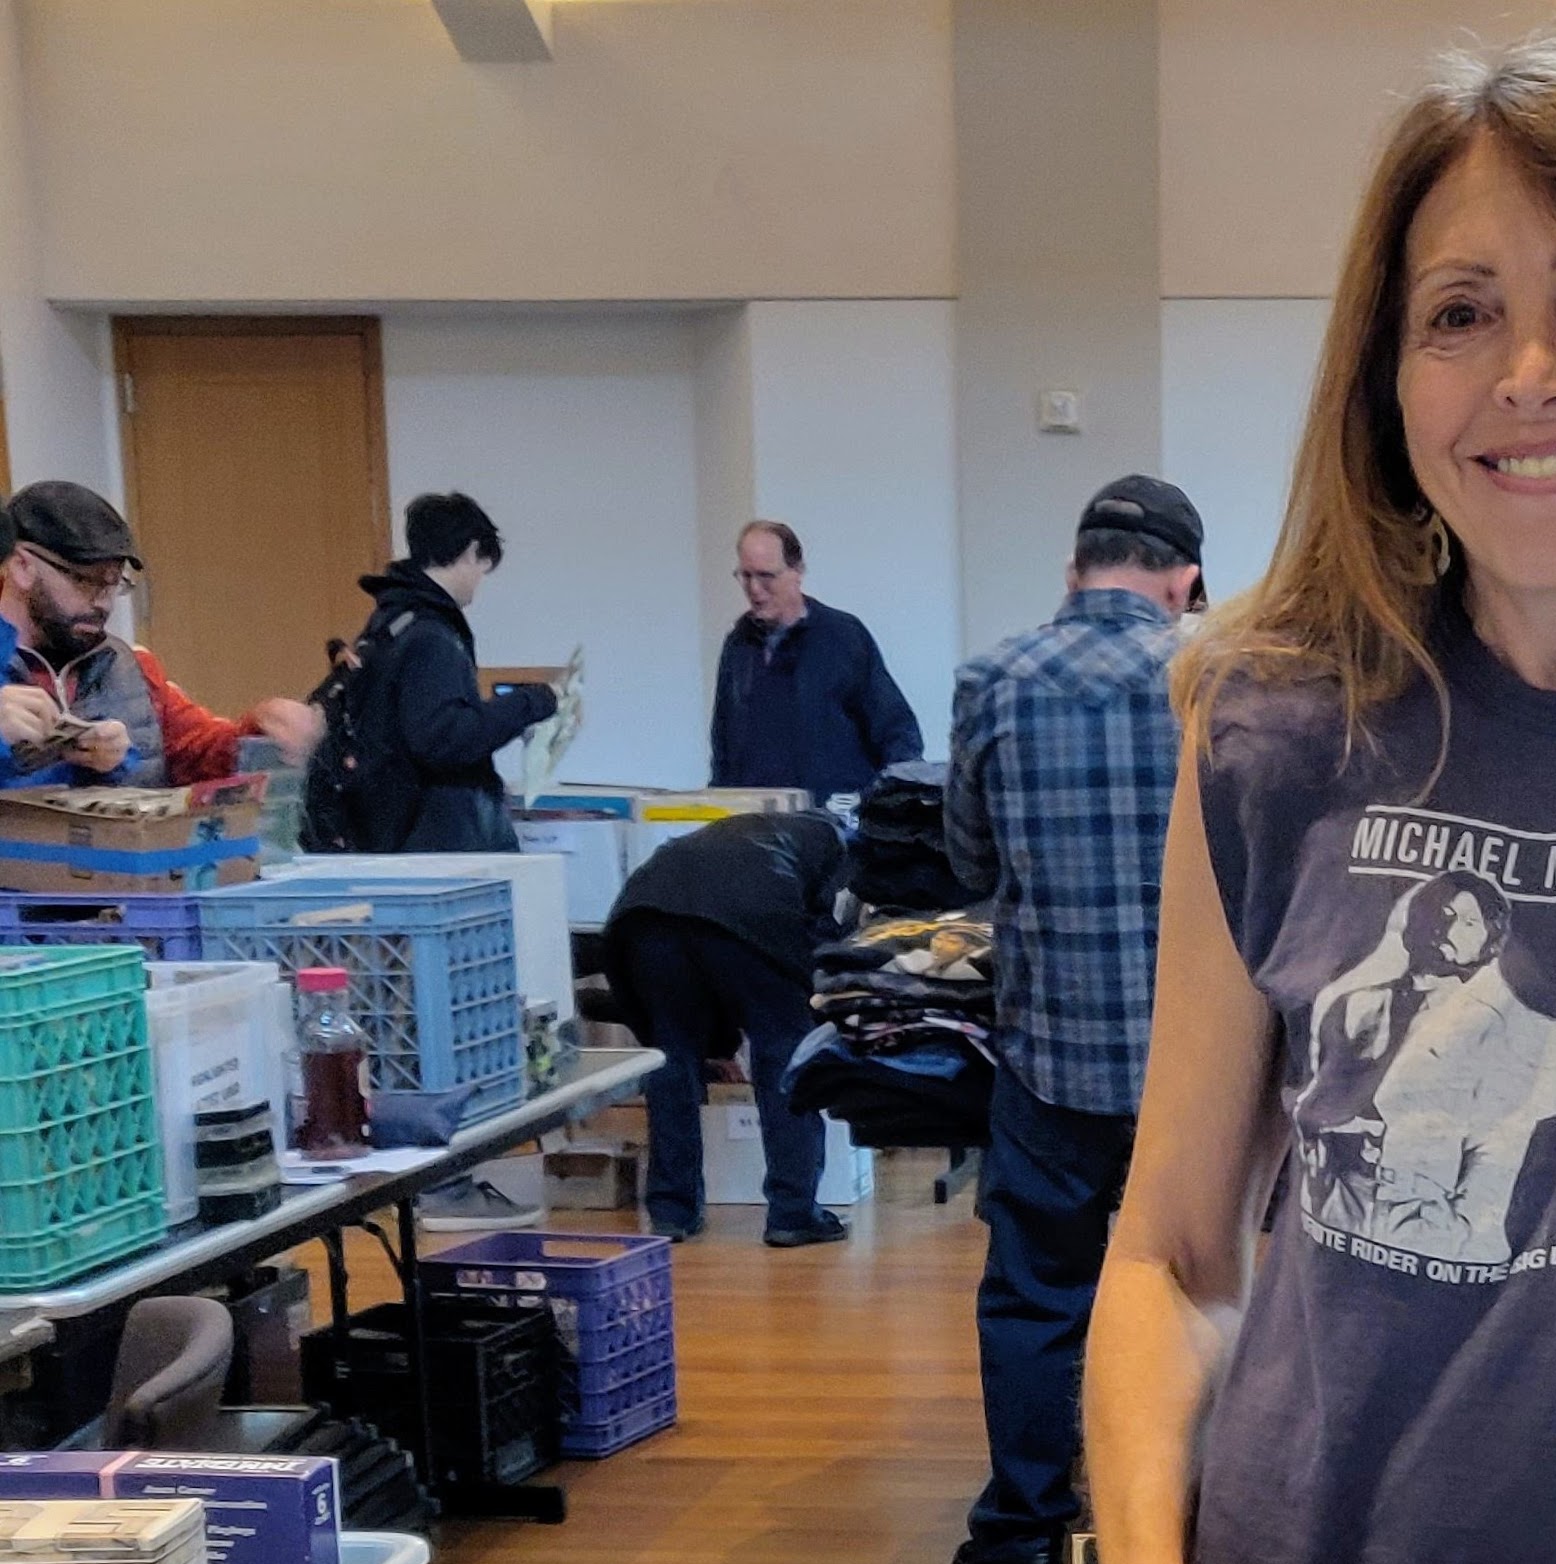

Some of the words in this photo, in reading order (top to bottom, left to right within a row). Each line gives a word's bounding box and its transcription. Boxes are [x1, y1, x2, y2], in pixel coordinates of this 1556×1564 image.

[1350, 816, 1523, 887] MICHAEL
[1351, 1236, 1420, 1277] RIDER
[1426, 1261, 1461, 1284] ON
[1466, 1263, 1511, 1284] THE
